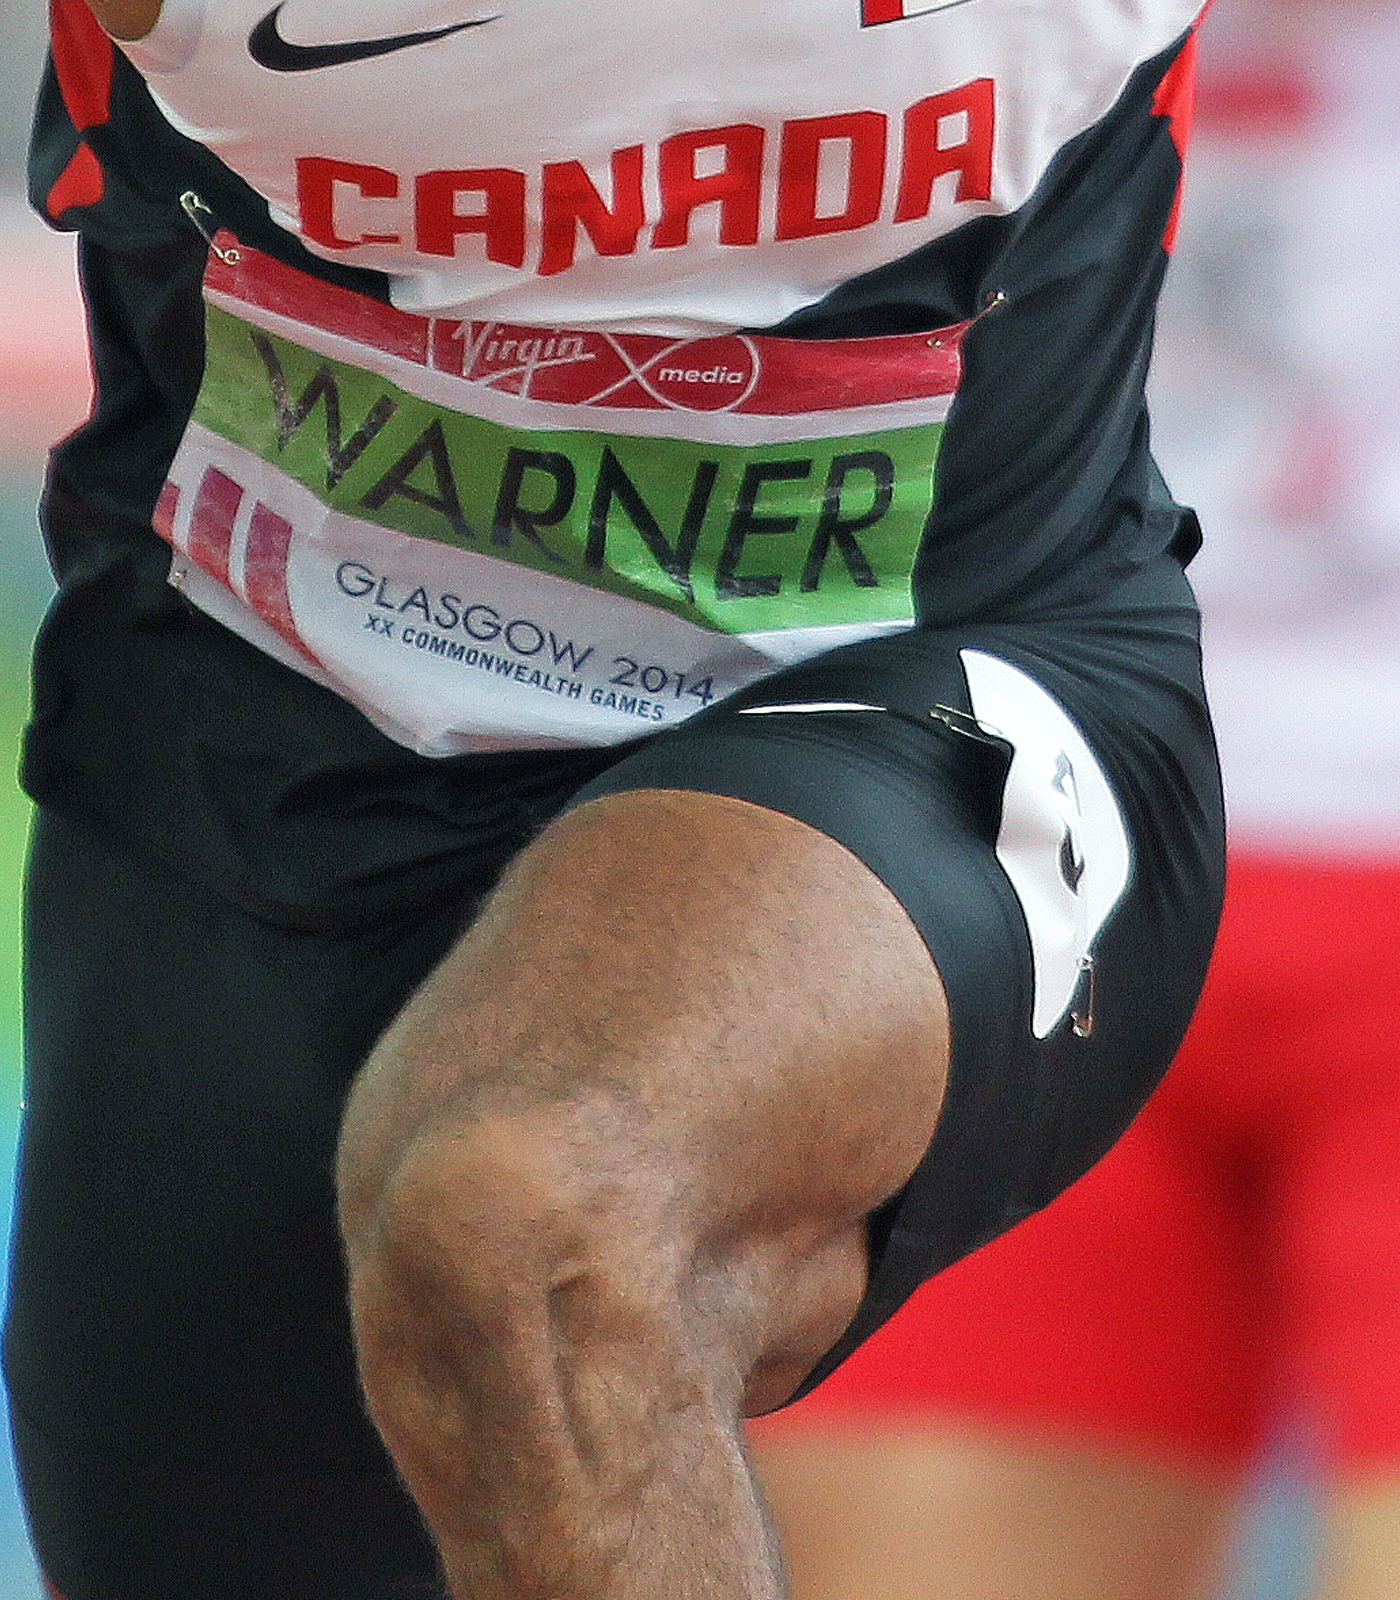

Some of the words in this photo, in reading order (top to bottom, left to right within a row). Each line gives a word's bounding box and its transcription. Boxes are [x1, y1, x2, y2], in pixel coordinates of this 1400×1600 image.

[296, 77, 997, 276] CANADA
[451, 319, 596, 399] Virgin
[658, 365, 745, 385] media
[250, 328, 897, 604] WARNER
[336, 562, 594, 672] GLASGOW
[610, 658, 715, 706] 2014
[363, 612, 395, 638] XX
[401, 626, 583, 699] COMMONWEALTH
[590, 687, 667, 721] GAMES
